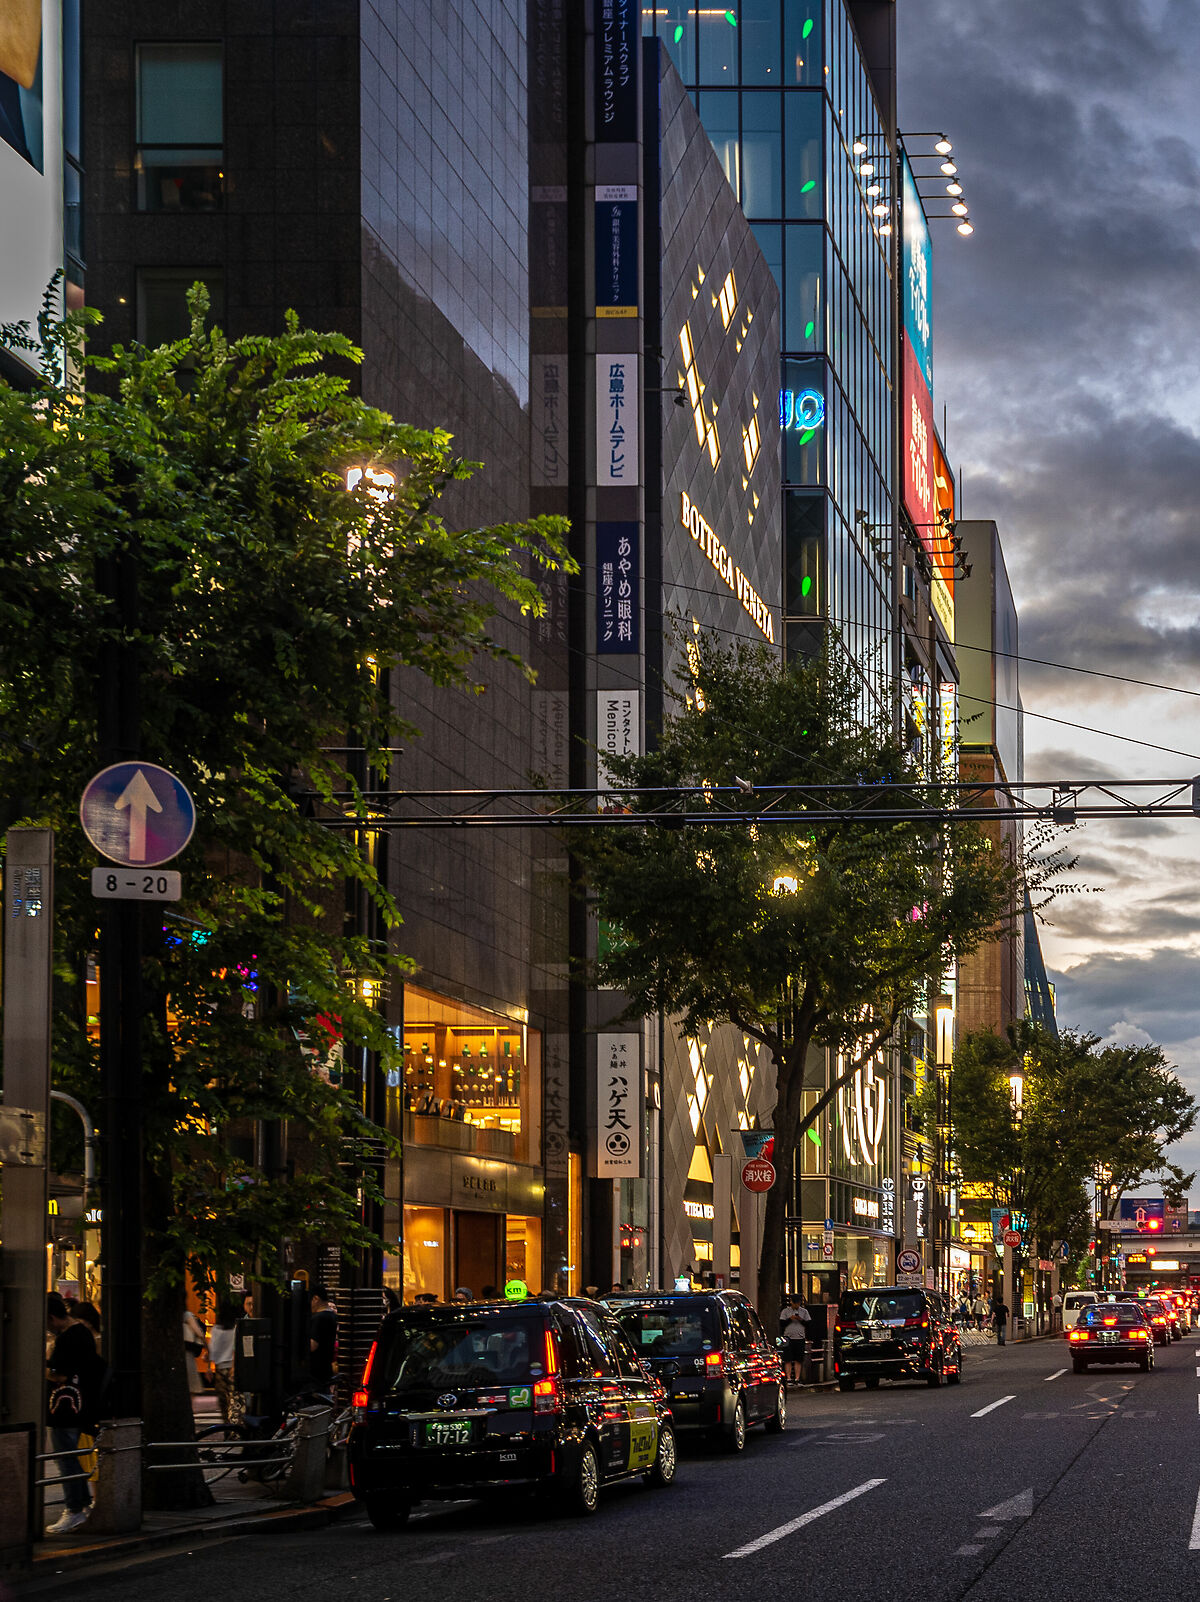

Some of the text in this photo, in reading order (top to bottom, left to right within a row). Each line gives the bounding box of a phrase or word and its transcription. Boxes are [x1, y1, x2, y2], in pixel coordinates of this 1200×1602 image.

[608, 363, 626, 479] 広島ホームテレビ
[681, 490, 775, 645] BOTTEGA VENETA
[602, 561, 614, 642] 銀座クリニック
[617, 536, 633, 642] あやめ眼科
[606, 700, 619, 757] Menicon
[619, 1044, 627, 1069] 天丼
[604, 1076, 632, 1131] ハゲ天
[745, 1168, 773, 1183] 消火栓
[506, 1287, 522, 1295] km
[693, 1358, 705, 1367] 05
[436, 1430, 470, 1444] 17-12
[501, 1454, 518, 1462] km
